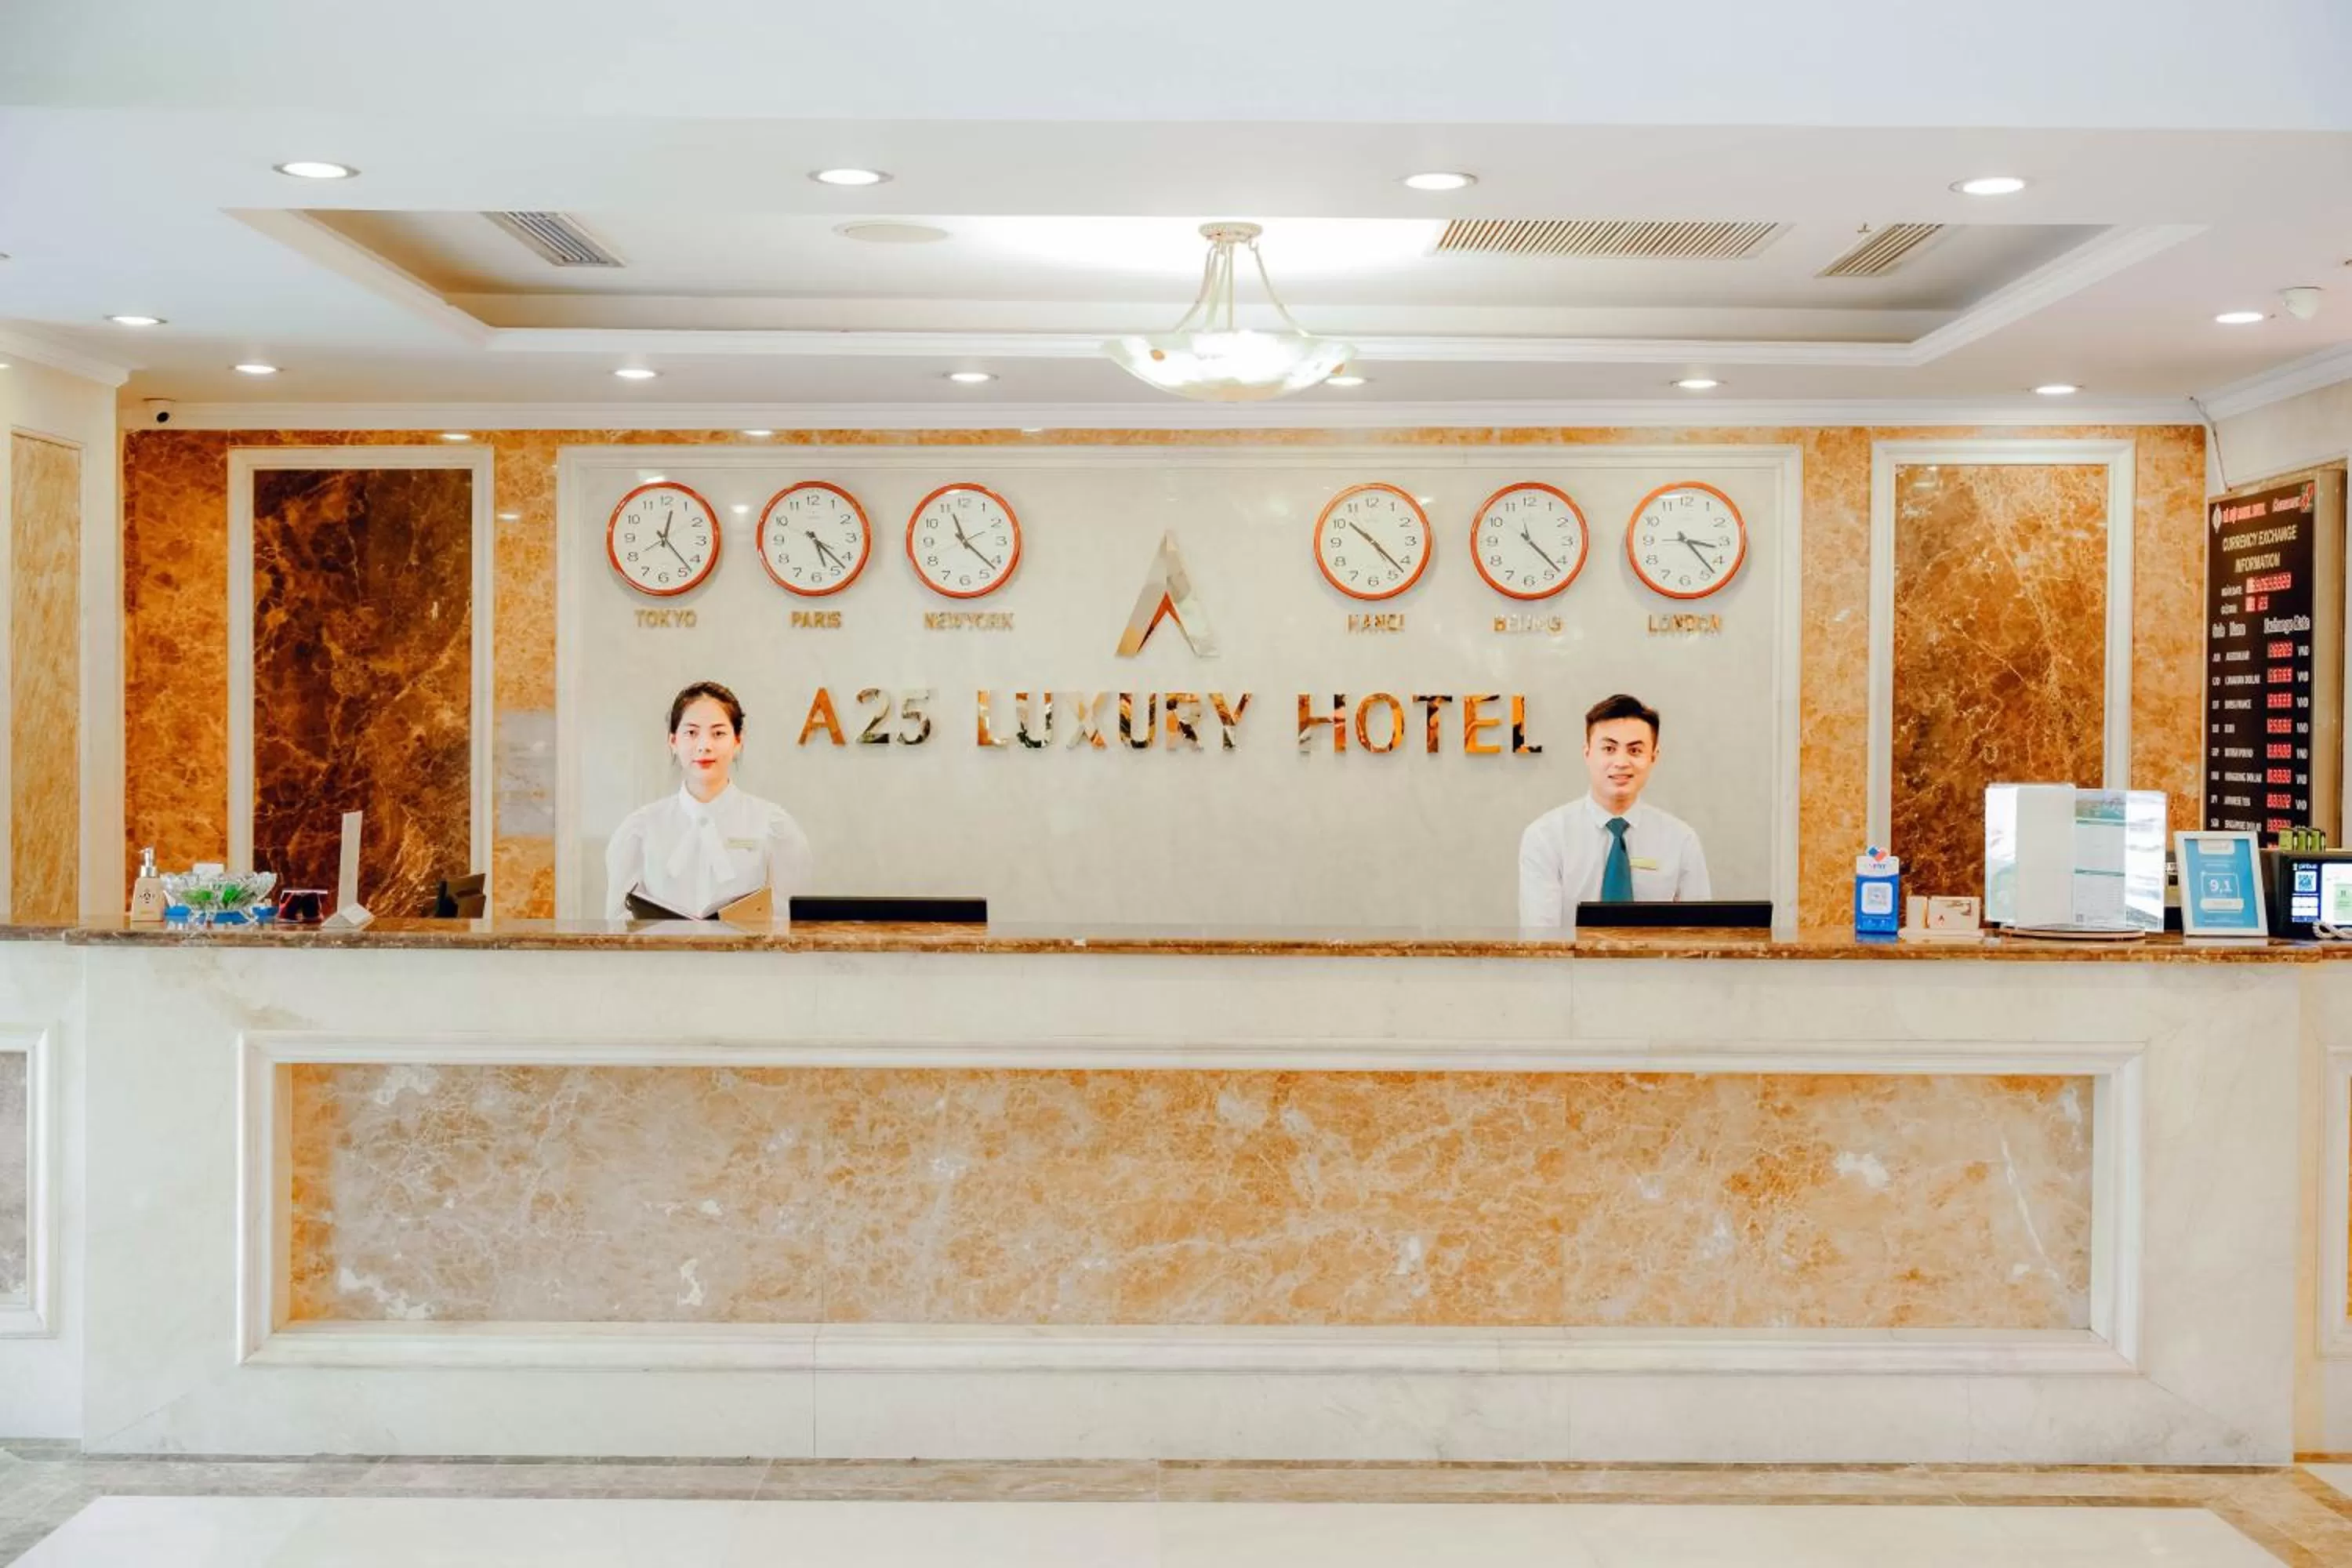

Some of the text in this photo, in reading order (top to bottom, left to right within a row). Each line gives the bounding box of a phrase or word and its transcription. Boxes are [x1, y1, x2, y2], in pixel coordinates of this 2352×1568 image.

[660, 495, 674, 506] 12
[807, 495, 819, 505] 12
[958, 499, 971, 508] 12
[1366, 498, 1379, 508] 12
[1523, 497, 1537, 506] 12
[1680, 496, 1693, 506] 12
[643, 501, 653, 510] 11
[940, 503, 950, 513] 11
[1348, 503, 1358, 513] 11
[1505, 503, 1515, 511] 11
[1663, 502, 1672, 511] 11
[627, 514, 640, 524] 10
[691, 517, 702, 527] 2
[776, 516, 788, 526] 10
[840, 514, 851, 524] 2
[926, 518, 938, 528] 10
[991, 517, 1001, 528] 2
[1334, 518, 1346, 528] 10
[1399, 517, 1410, 527] 2
[1490, 517, 1503, 527] 10
[1557, 517, 1568, 527] 2
[1646, 516, 1659, 527] 10
[1714, 517, 1726, 527] 2
[624, 533, 635, 543] 9
[846, 533, 857, 543] 3
[2258, 524, 2297, 545] EXCHANGE
[696, 535, 706, 546] 3
[774, 535, 784, 545] 9
[923, 537, 935, 547] 9
[996, 535, 1007, 546] 3
[1330, 537, 1341, 547] 9
[1405, 536, 1417, 546] 3
[1486, 536, 1497, 546] 9
[1563, 536, 1573, 546] 3
[1643, 535, 1654, 545] 9
[1720, 536, 1730, 546] 3
[627, 552, 639, 561] 8
[690, 554, 700, 564] 4
[779, 554, 789, 564] 8
[842, 552, 853, 561] 4
[927, 556, 938, 566] 8
[991, 555, 1001, 564] 4
[1334, 557, 1346, 566] 8
[1400, 556, 1410, 564] 4
[1490, 555, 1502, 566] 8
[1557, 555, 1567, 564] 4
[1646, 554, 1658, 564] 8
[1713, 556, 1723, 564] 4
[2235, 552, 2281, 573] INFORMATION
[641, 566, 649, 576] 7
[678, 568, 688, 577] 5
[793, 567, 802, 577] 7
[830, 566, 840, 575] 5
[942, 571, 950, 580] 7
[979, 570, 990, 579] 5
[1388, 571, 1399, 580] 5
[1505, 571, 1514, 580] 7
[1544, 571, 1554, 580] 5
[1661, 569, 1671, 579] 7
[659, 572, 669, 583] 6
[811, 572, 822, 583] 6
[960, 575, 971, 586] 6
[1348, 571, 1359, 581] 7
[1368, 576, 1379, 586] 6
[1523, 575, 1535, 586] 6
[1679, 575, 1691, 586] 6
[1700, 571, 1711, 581] 5
[634, 609, 697, 628] TOKYO
[791, 611, 842, 628] PARIS
[798, 688, 1542, 754] A25 LUXURY HOTEL
